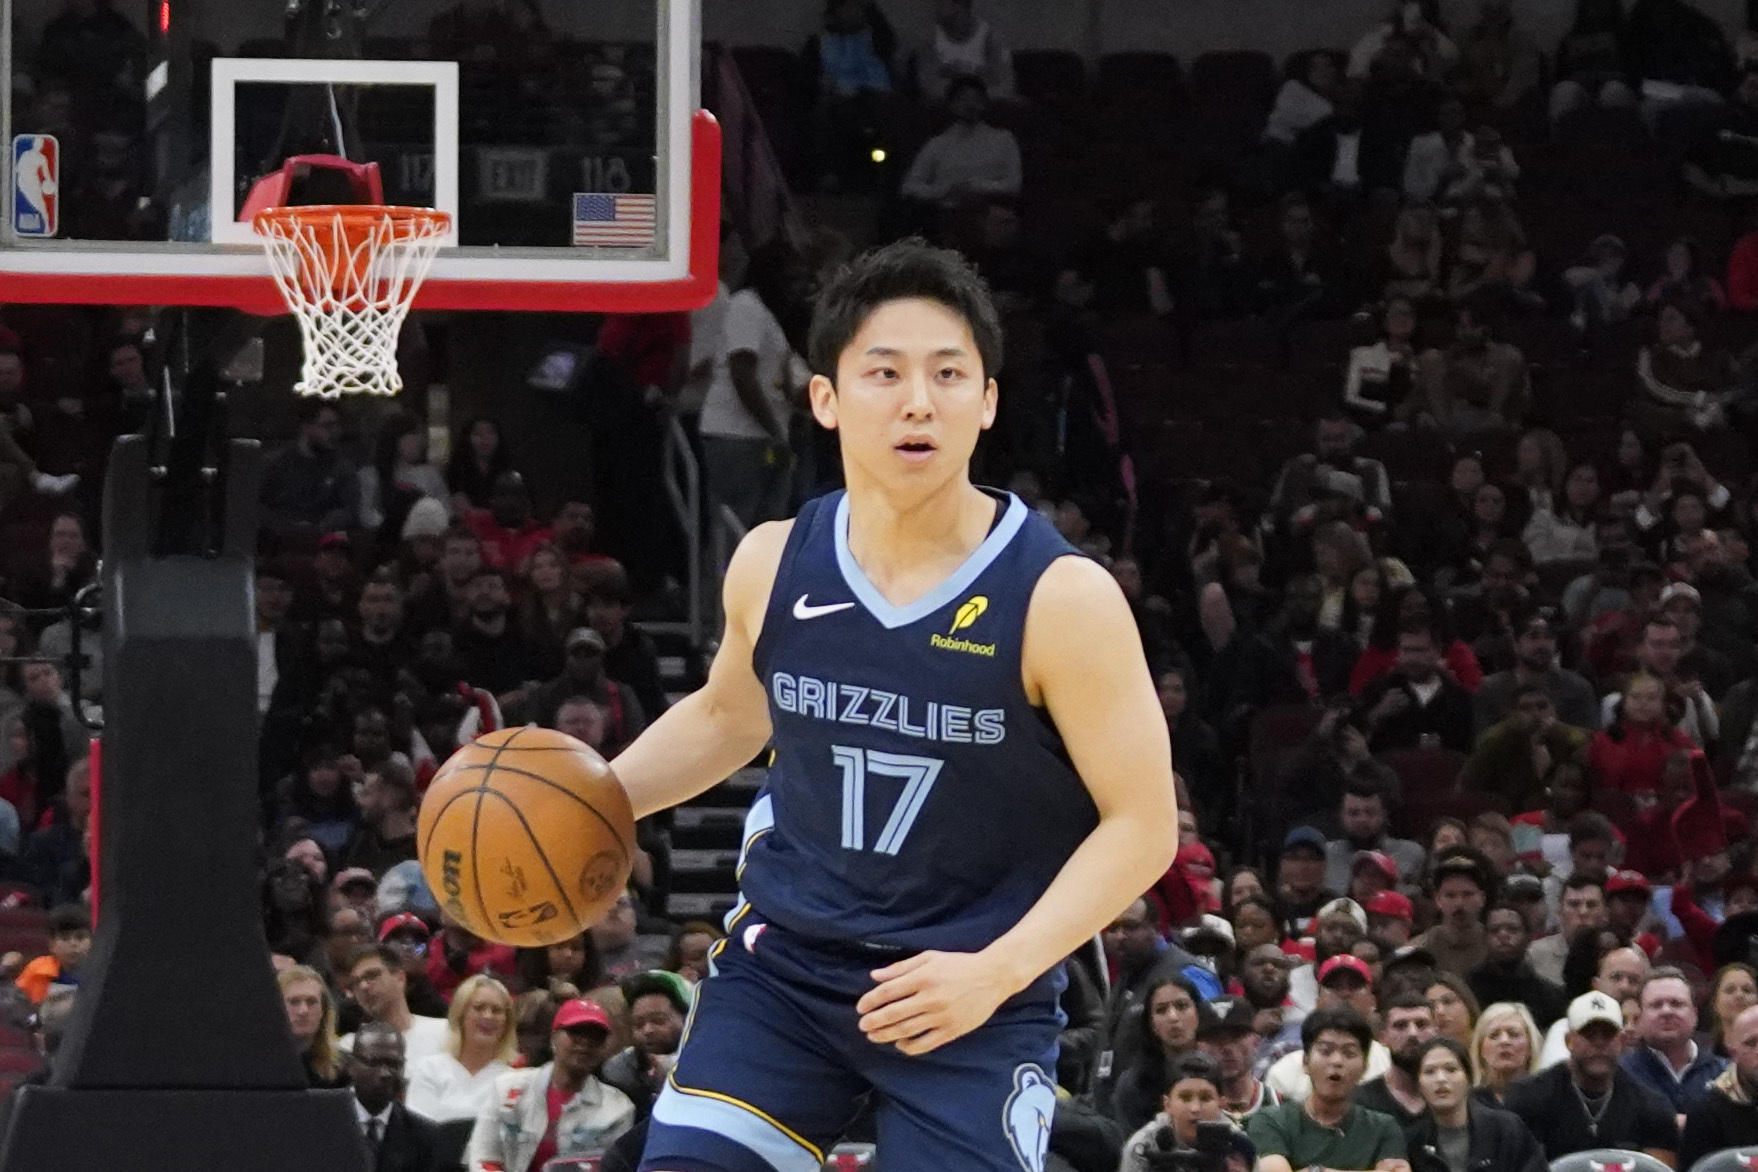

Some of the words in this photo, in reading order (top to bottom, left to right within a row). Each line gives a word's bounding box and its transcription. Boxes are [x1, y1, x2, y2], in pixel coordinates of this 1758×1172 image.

[930, 633, 995, 657] Robinhood
[772, 671, 1005, 745] GRIZZLIES
[831, 744, 944, 856] 17
